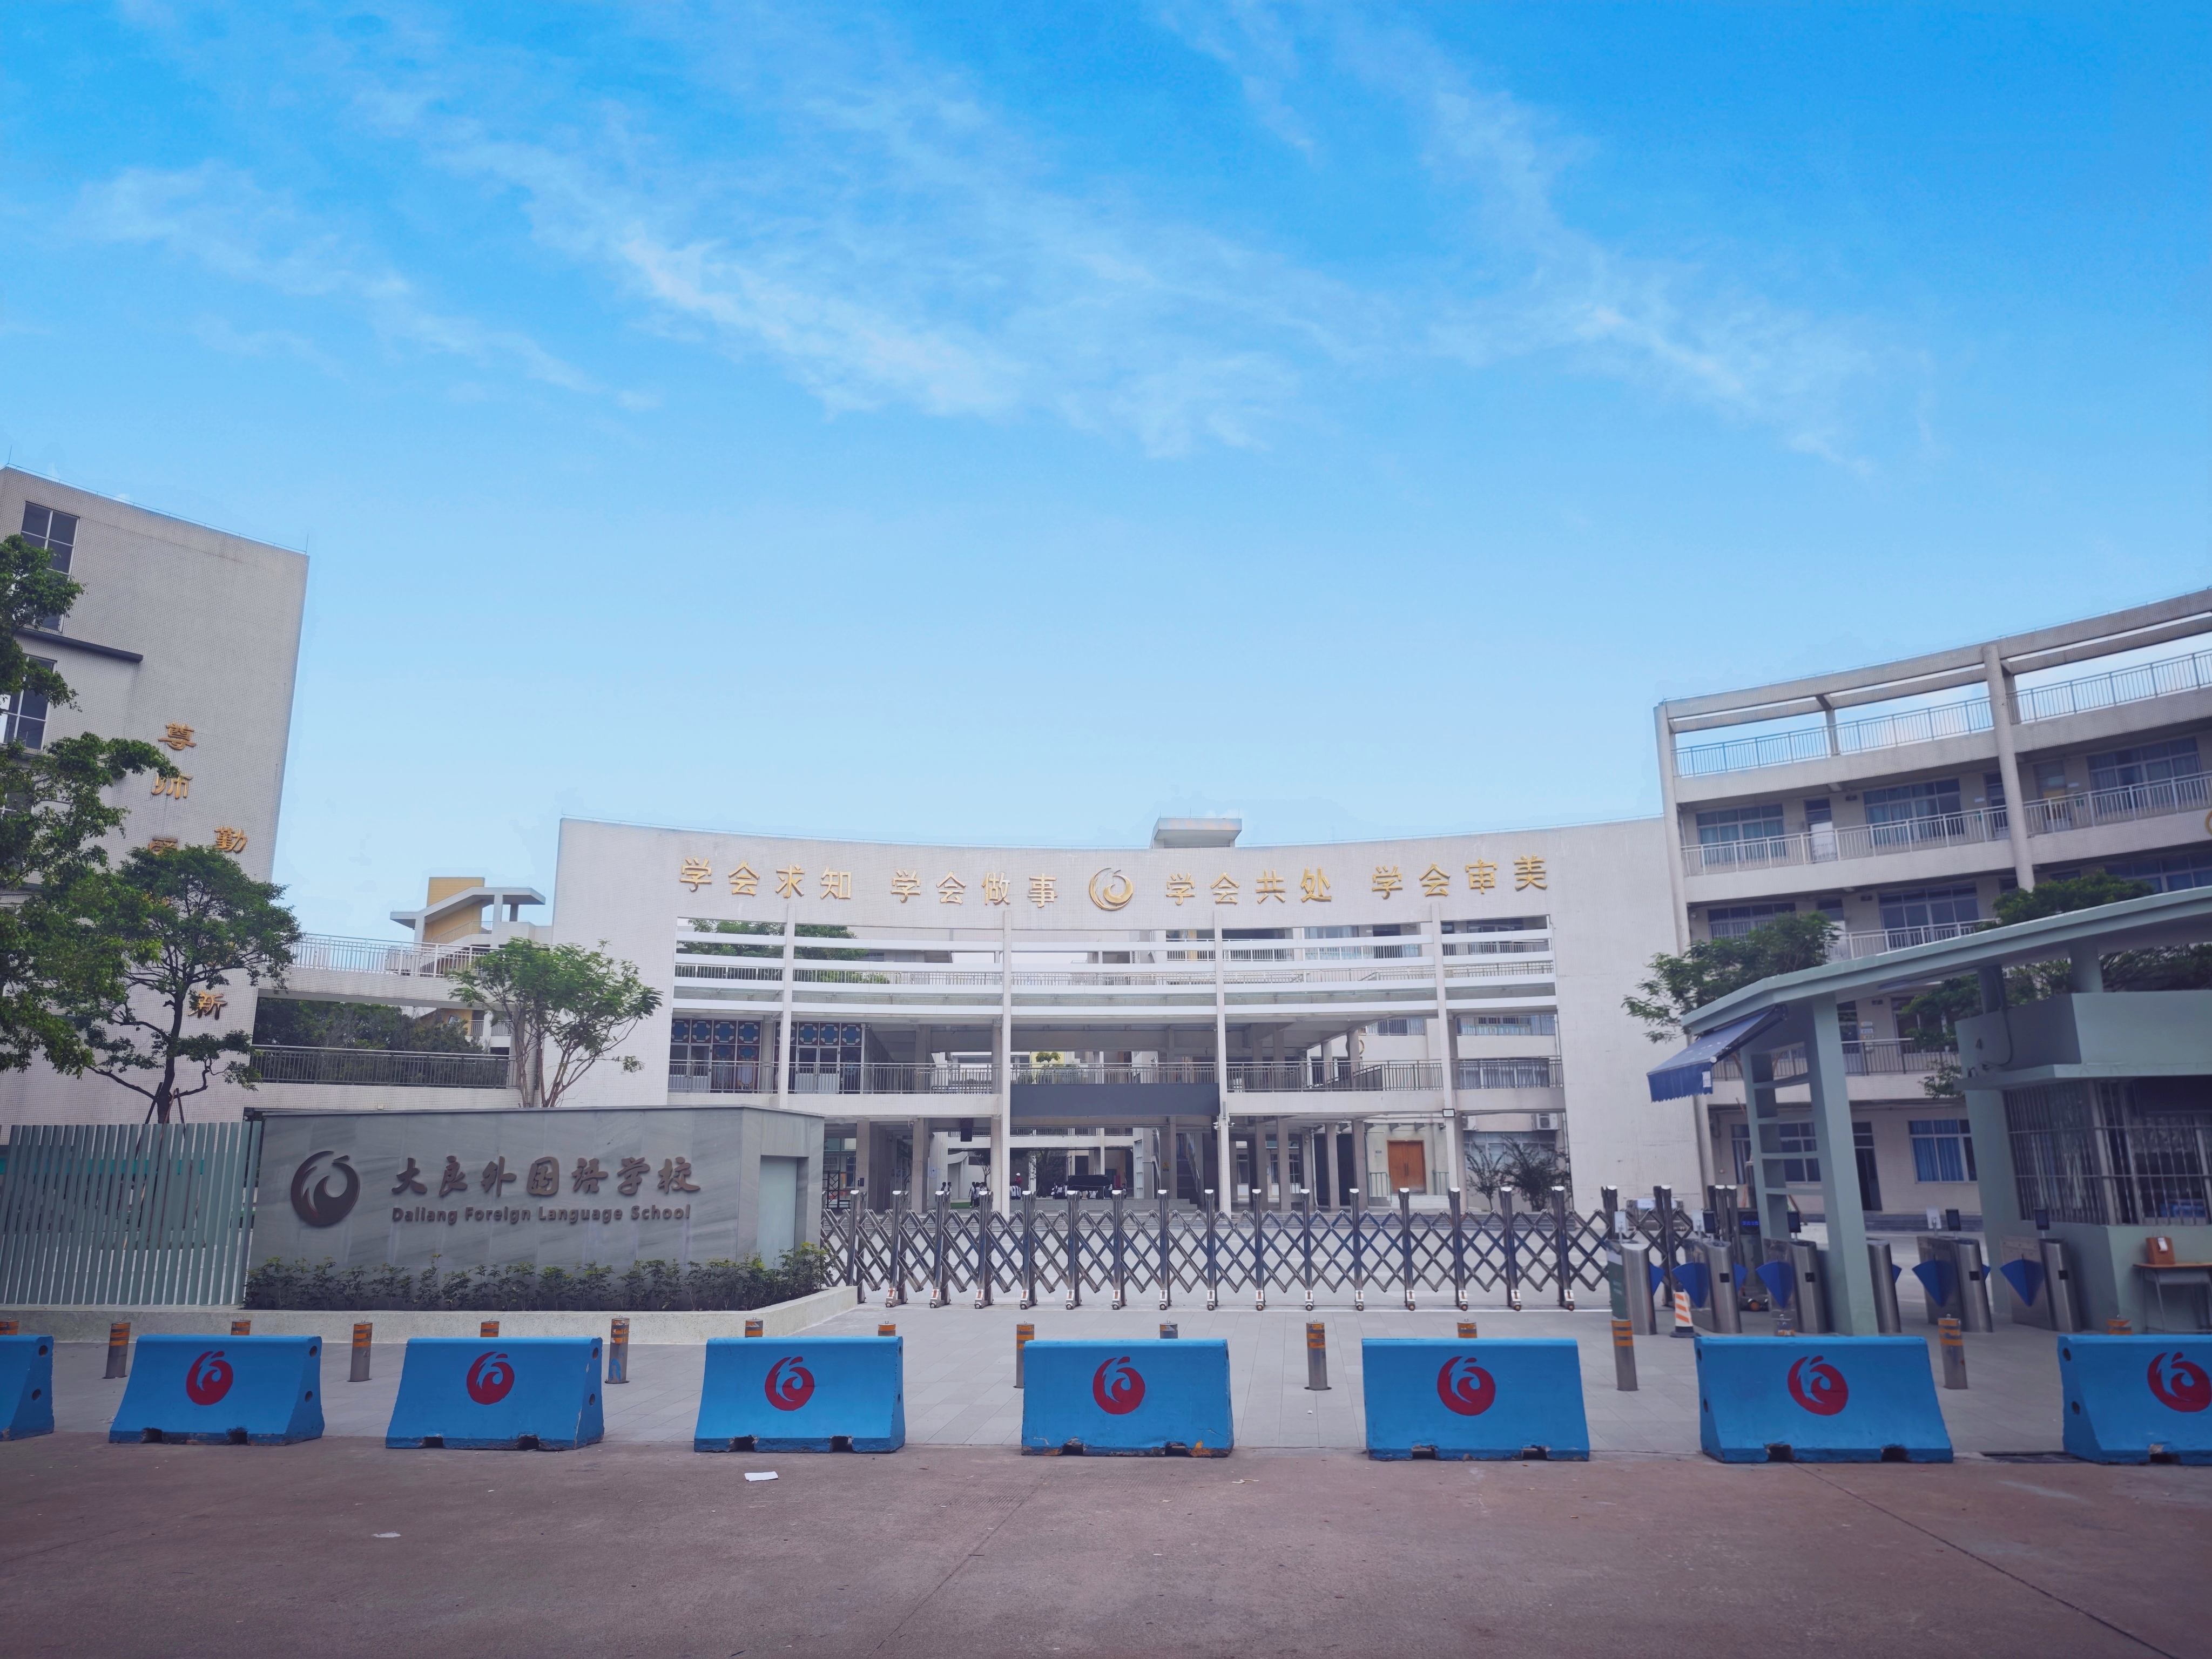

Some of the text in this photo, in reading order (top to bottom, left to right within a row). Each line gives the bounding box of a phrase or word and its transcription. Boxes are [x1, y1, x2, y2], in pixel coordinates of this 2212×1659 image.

[679, 853, 1548, 908] 学会求知 学会做事 学会共处 学会审美
[187, 826, 248, 1021] 勤新
[392, 1204, 691, 1225] Daliang Foreign Language School
